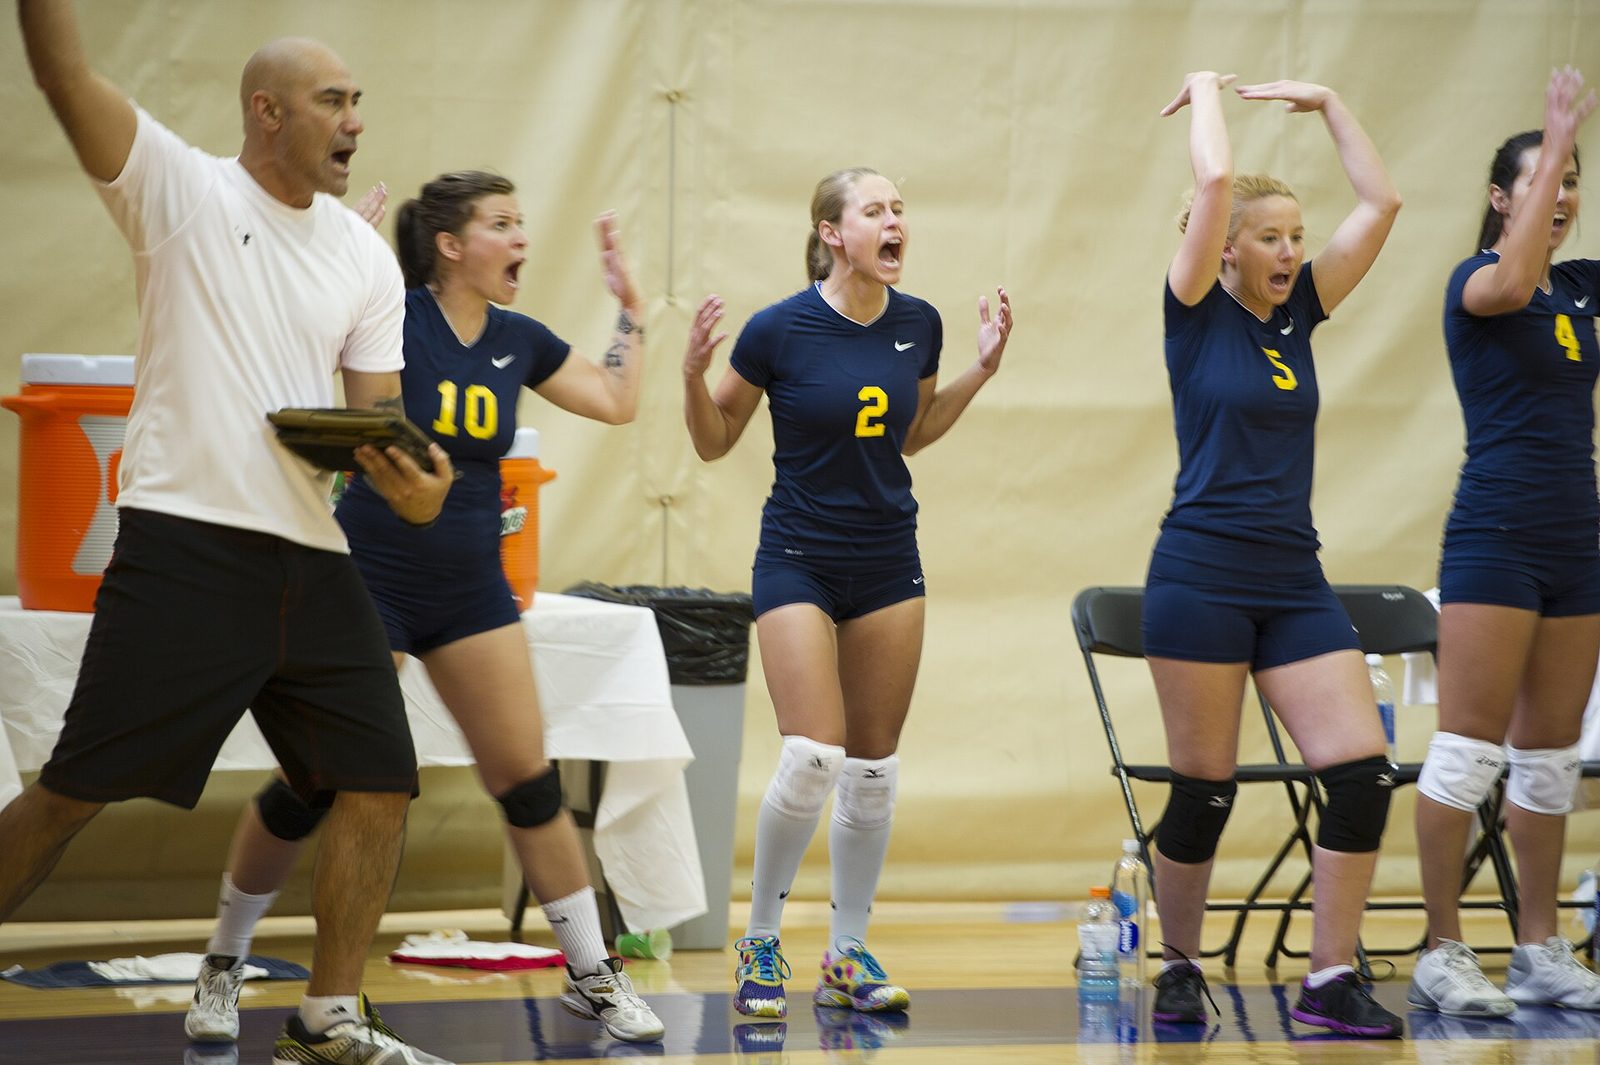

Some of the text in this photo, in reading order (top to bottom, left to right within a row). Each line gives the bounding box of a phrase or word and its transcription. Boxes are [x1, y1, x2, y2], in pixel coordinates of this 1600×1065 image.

[1554, 313, 1582, 362] 4
[1260, 346, 1298, 390] 5
[432, 379, 499, 440] 10
[855, 386, 889, 438] 2
